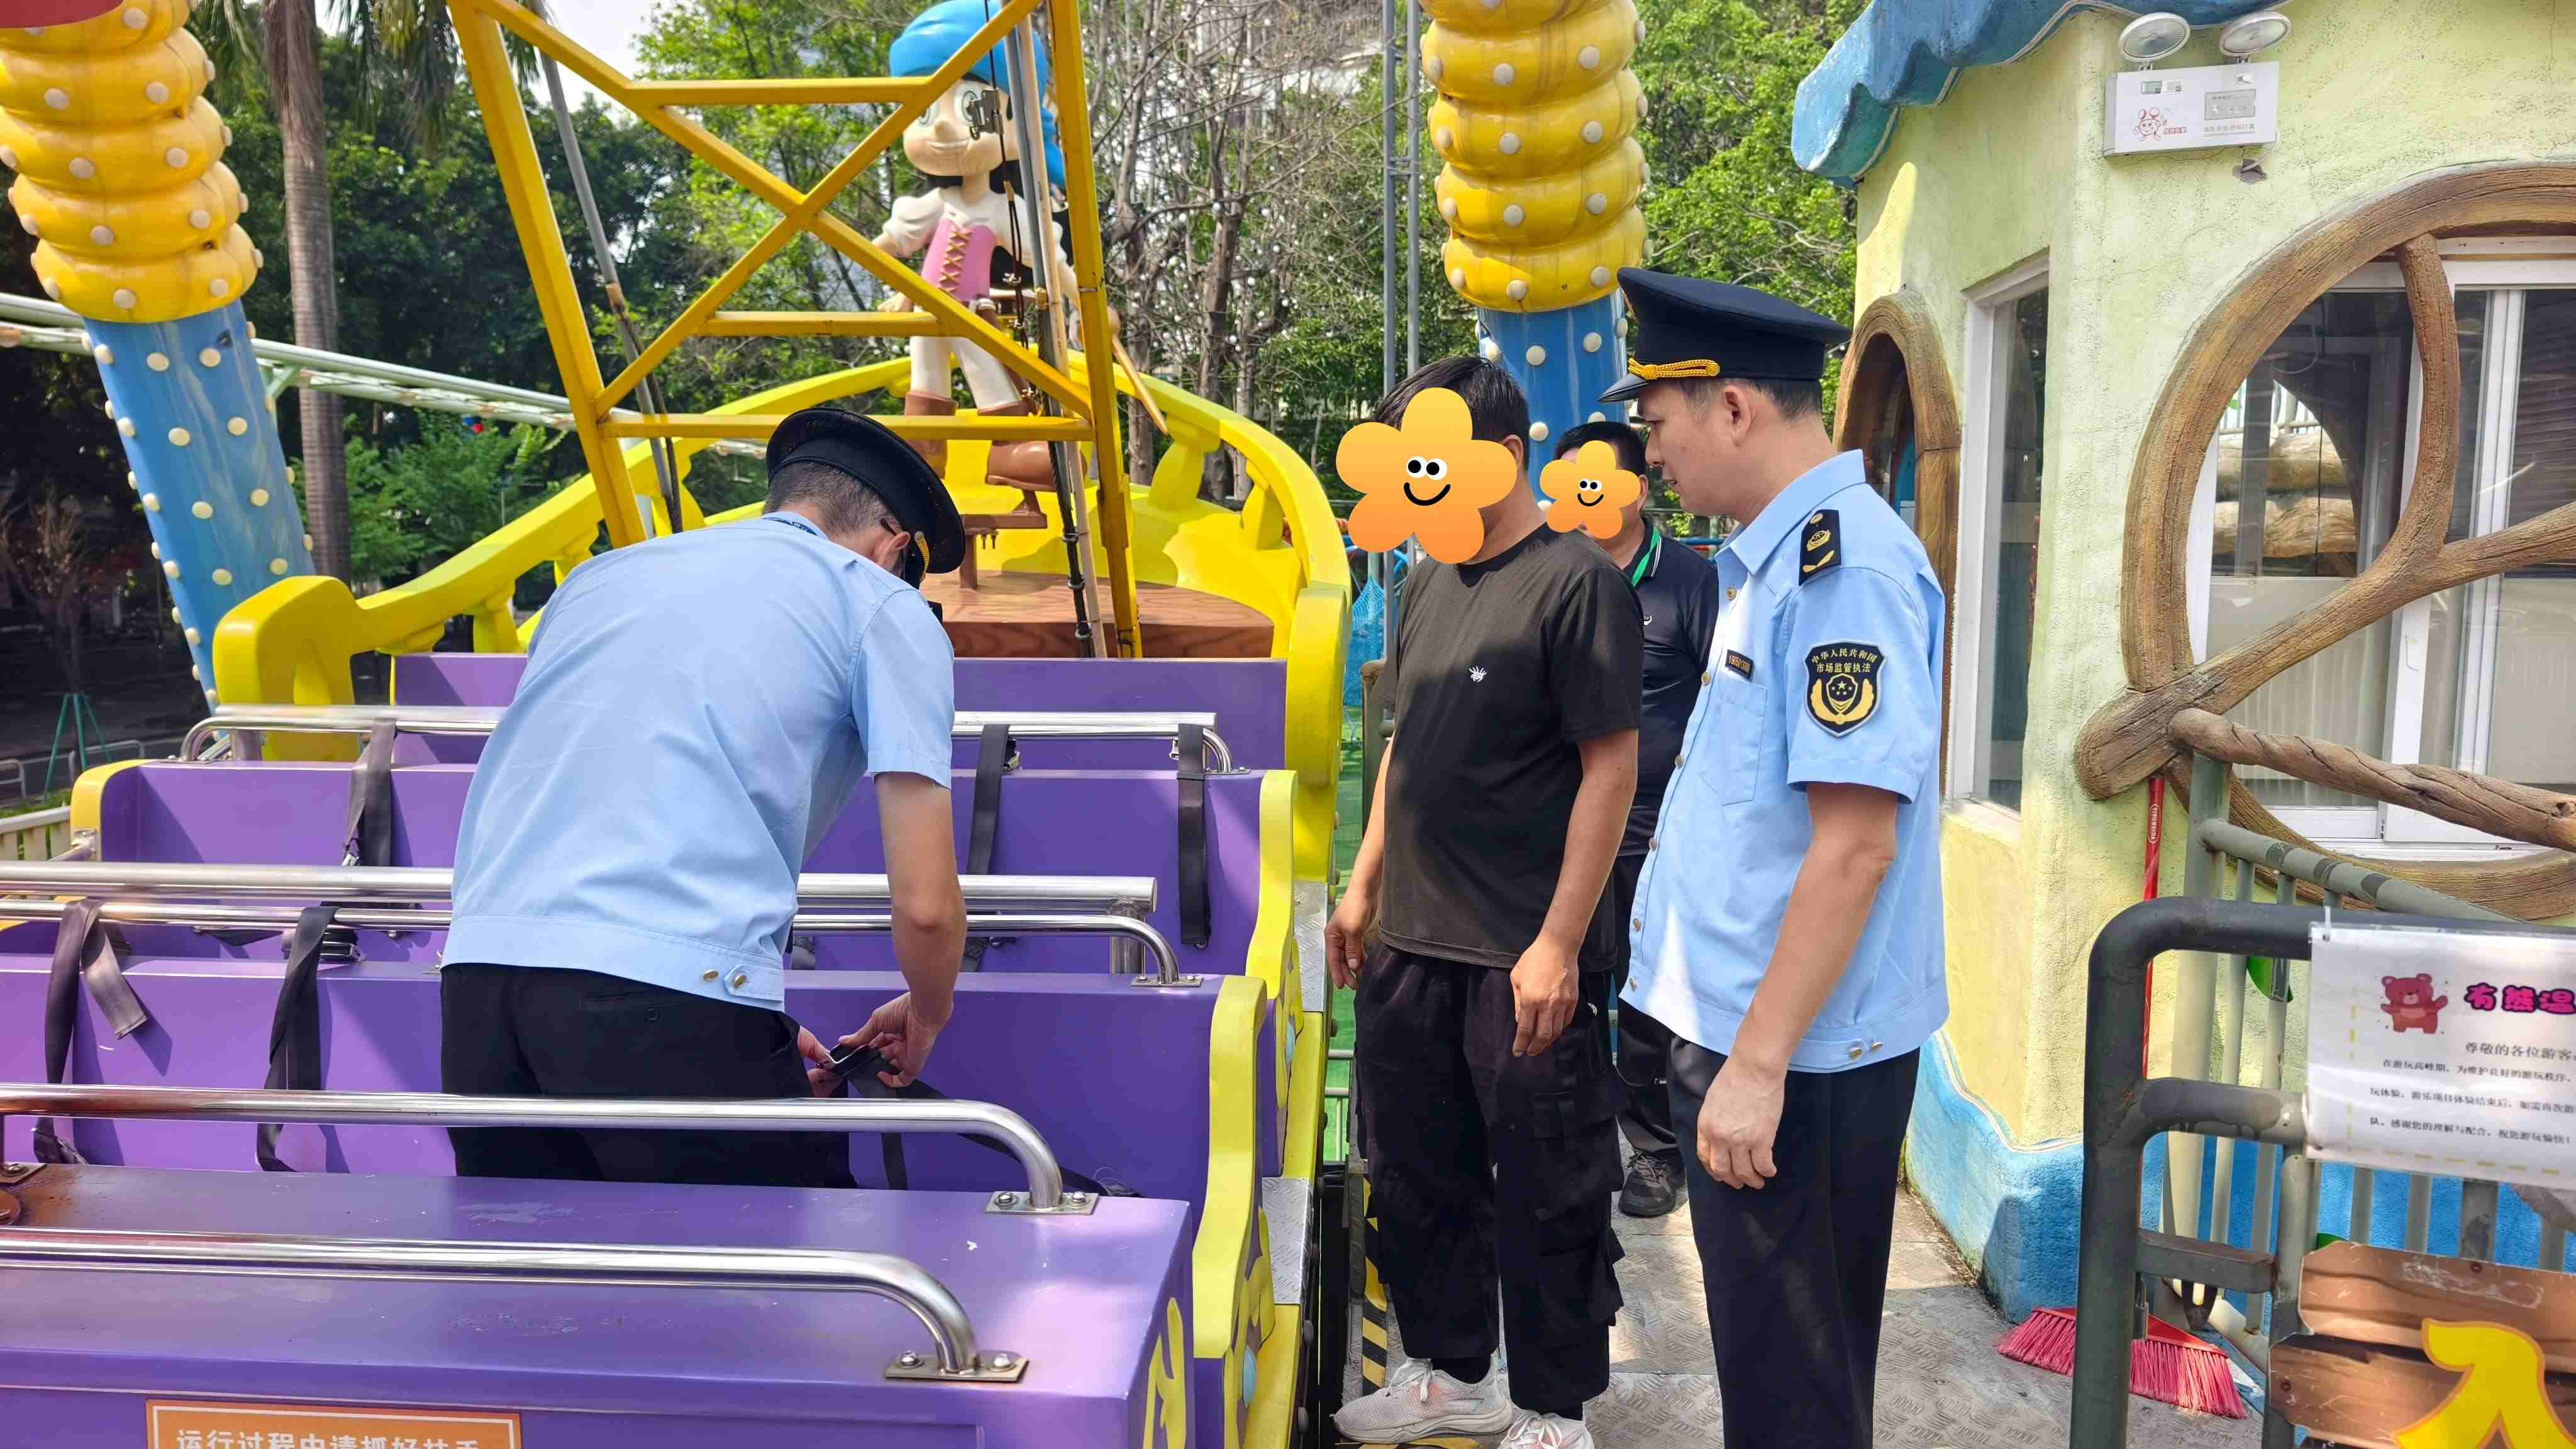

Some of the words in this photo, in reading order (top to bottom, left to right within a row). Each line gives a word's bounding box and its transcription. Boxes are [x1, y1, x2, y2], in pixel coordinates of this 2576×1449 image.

[1812, 648, 1877, 663] 中华人民共和国
[1816, 663, 1870, 673] 市场监管执法
